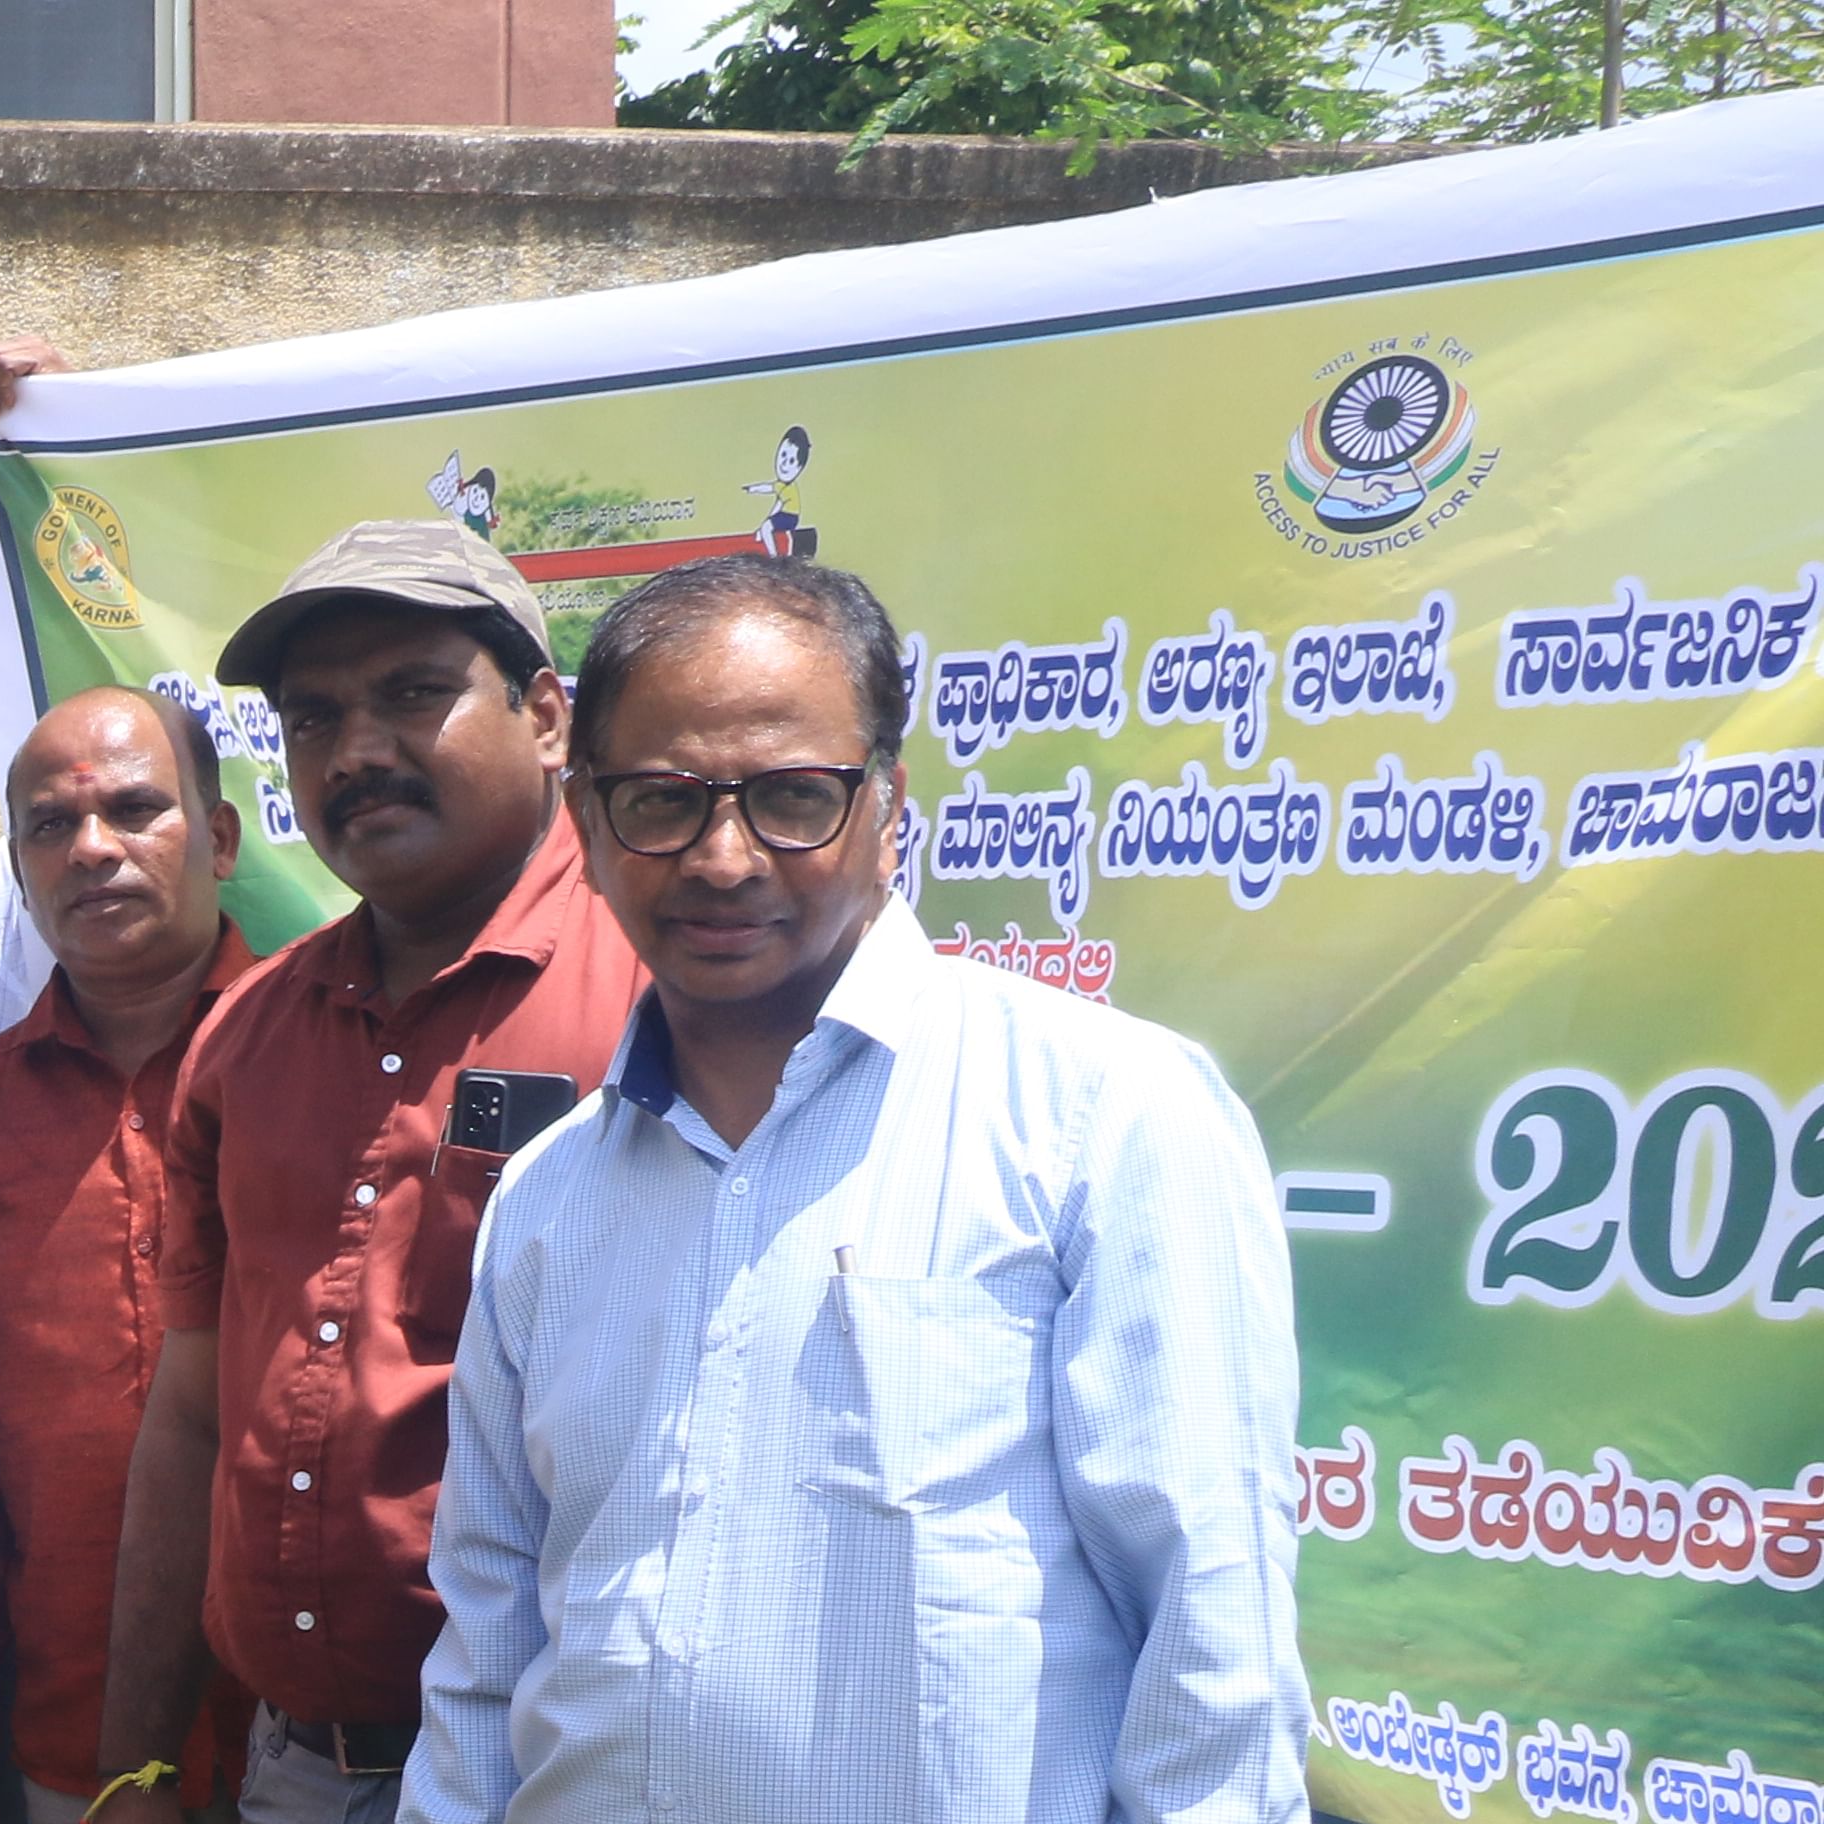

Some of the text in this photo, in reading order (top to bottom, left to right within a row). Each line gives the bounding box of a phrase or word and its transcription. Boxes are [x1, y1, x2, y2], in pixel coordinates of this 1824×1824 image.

[1368, 336, 1399, 354] सब
[1411, 331, 1430, 350] के
[1438, 336, 1473, 368] लिए
[105, 524, 122, 548] OF
[1254, 446, 1502, 559] ACCESS TO JUSTICE FOR ALL
[936, 626, 1120, 757] ಪ್ರಾಧಿಕಾರ,
[1146, 618, 1266, 759] ಅರಣ್ಯ
[1291, 600, 1444, 714] ಇಲಾಖೆ,
[1505, 574, 1817, 697] ಸಾರ್ವಜನಿಕ
[938, 776, 1088, 915] ಮಾಲಿನ್ಯ
[1107, 768, 1321, 899] ನಿಯಂತ್ರಣ
[1345, 760, 1540, 872] ಮಂಡಳಿ,
[1568, 750, 1824, 858] ಚಾಮರಾಜ
[1333, 1697, 1501, 1812] ಅಂಬೇಡ್ಕರ್
[1524, 1724, 1630, 1823] ಭವನ,
